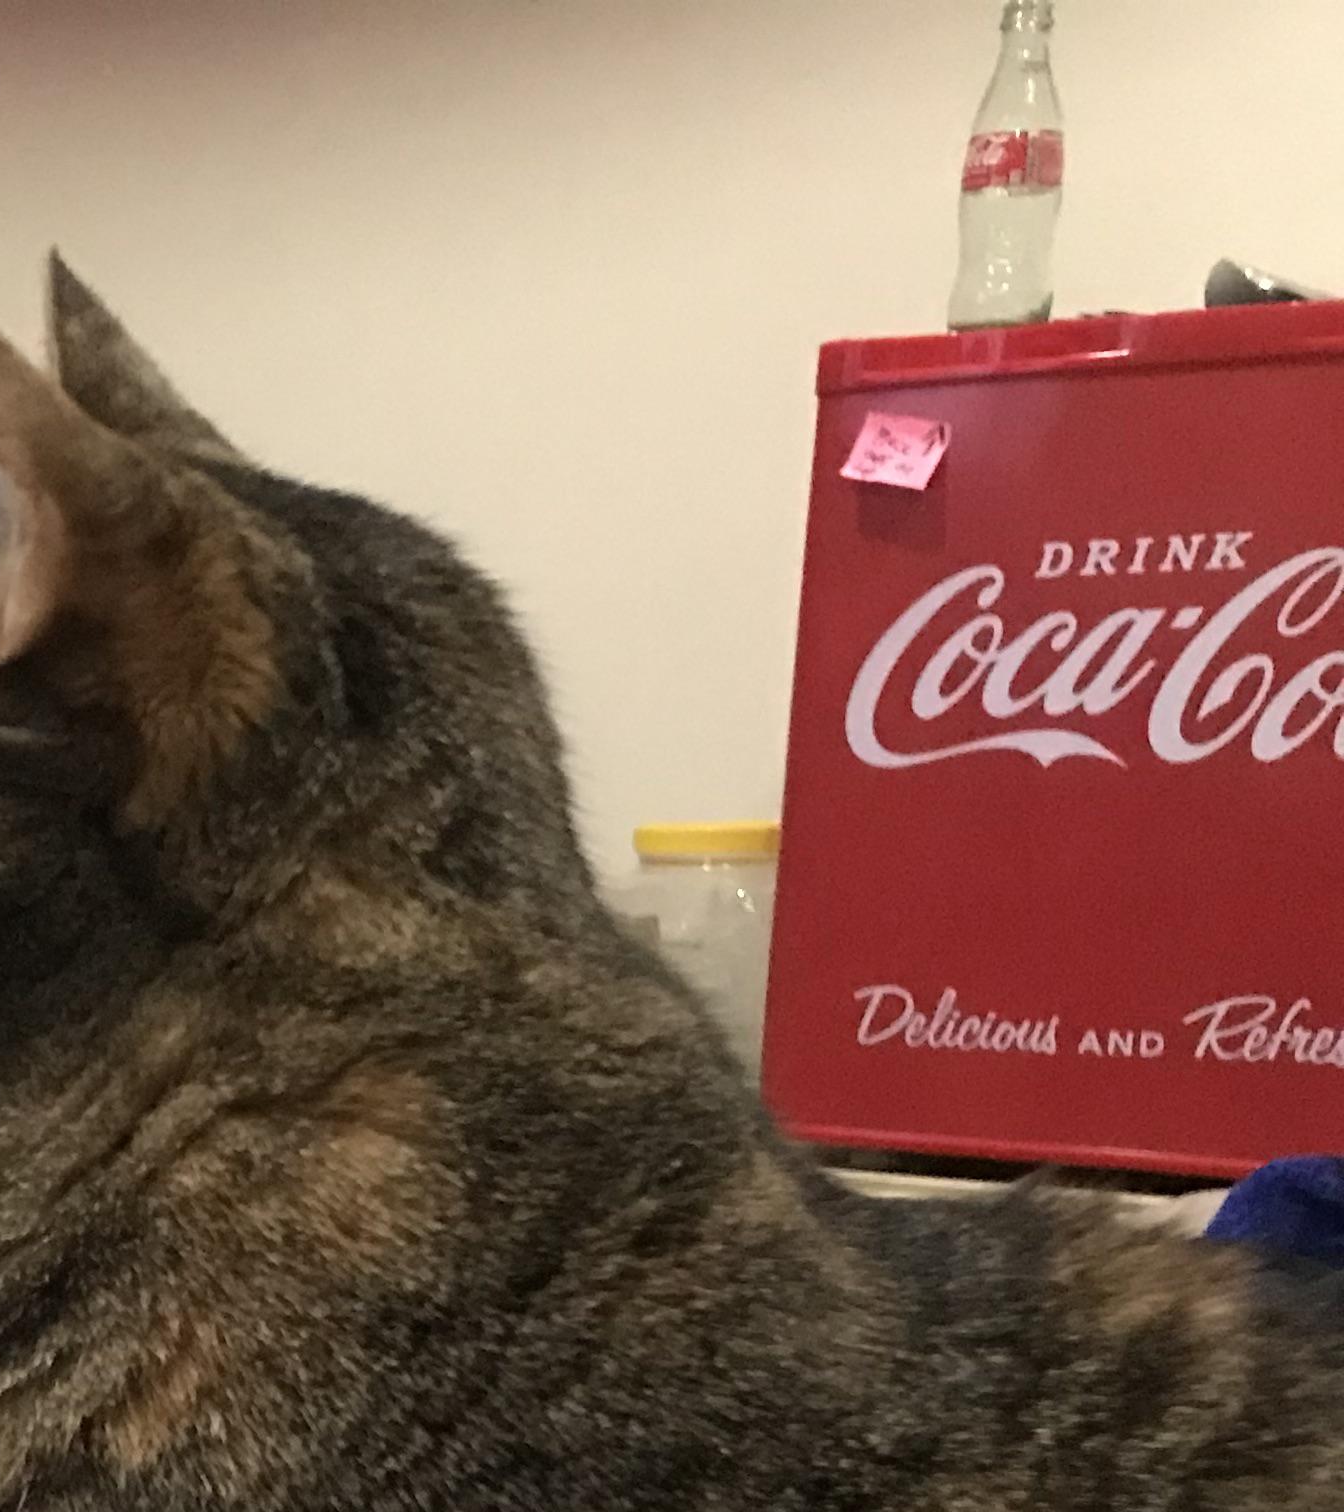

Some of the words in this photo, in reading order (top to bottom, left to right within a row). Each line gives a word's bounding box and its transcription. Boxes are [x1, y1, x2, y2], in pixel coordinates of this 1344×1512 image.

[1034, 531, 1253, 579] DRINK
[854, 984, 1059, 1056] Delicious
[1078, 1029, 1165, 1059] AND
